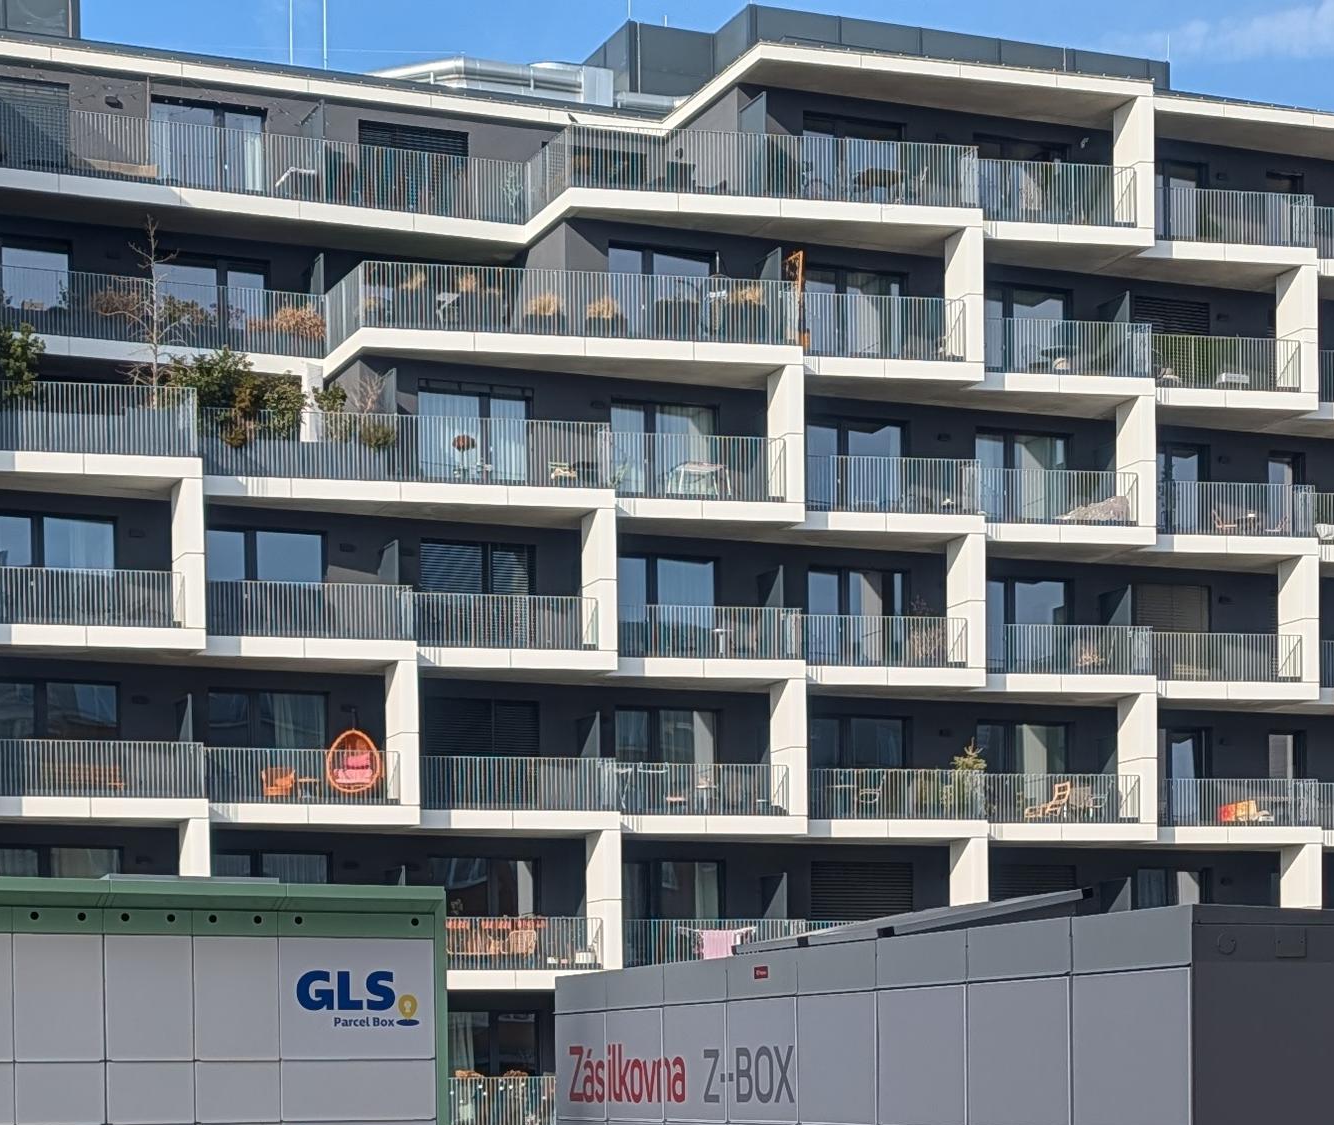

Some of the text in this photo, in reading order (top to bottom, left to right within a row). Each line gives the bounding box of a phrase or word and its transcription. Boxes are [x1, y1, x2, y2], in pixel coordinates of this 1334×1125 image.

[296, 970, 396, 1012] GLS
[334, 1016, 395, 1027] Parcel Box
[569, 1043, 795, 1104] Zásilkovna Z-BOX
